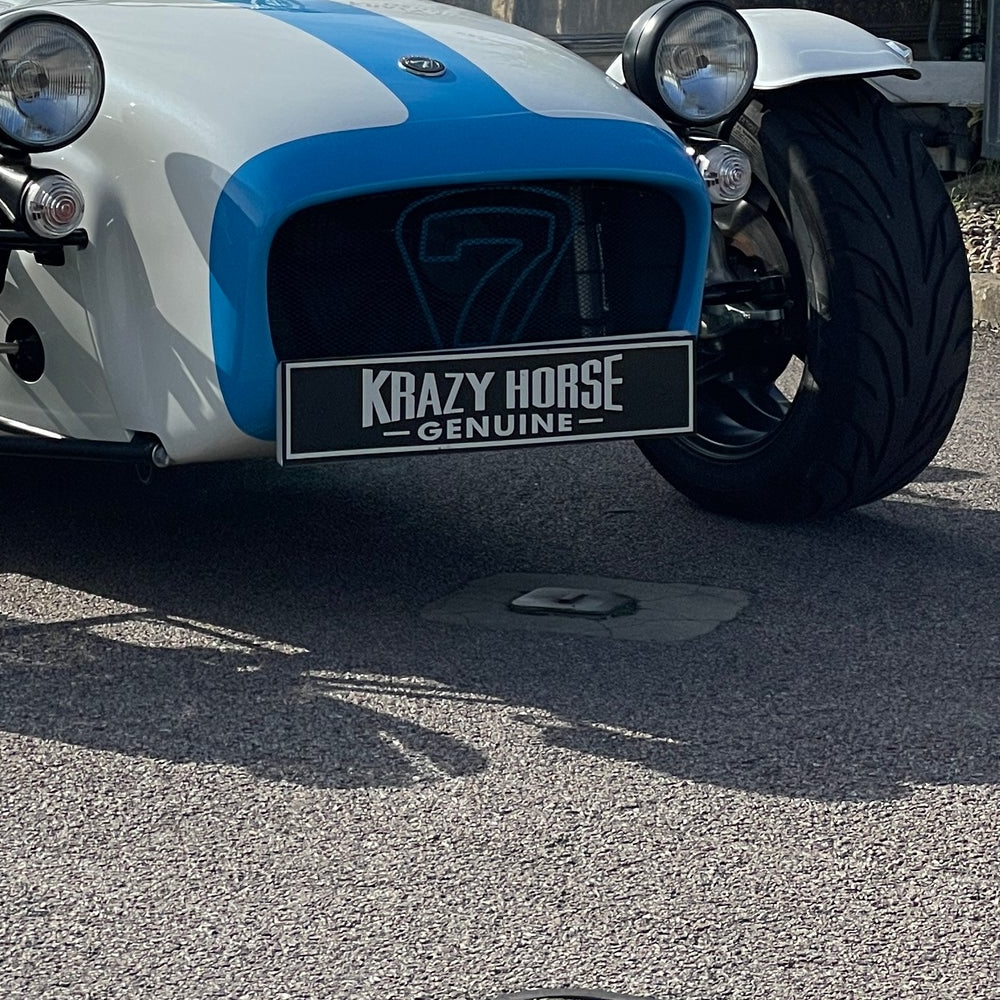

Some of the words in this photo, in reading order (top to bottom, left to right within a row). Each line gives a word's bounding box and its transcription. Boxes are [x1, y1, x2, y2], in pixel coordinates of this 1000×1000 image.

[361, 368, 495, 428] KRAZY
[506, 353, 624, 412] HORSE
[417, 412, 573, 442] GENUINE
